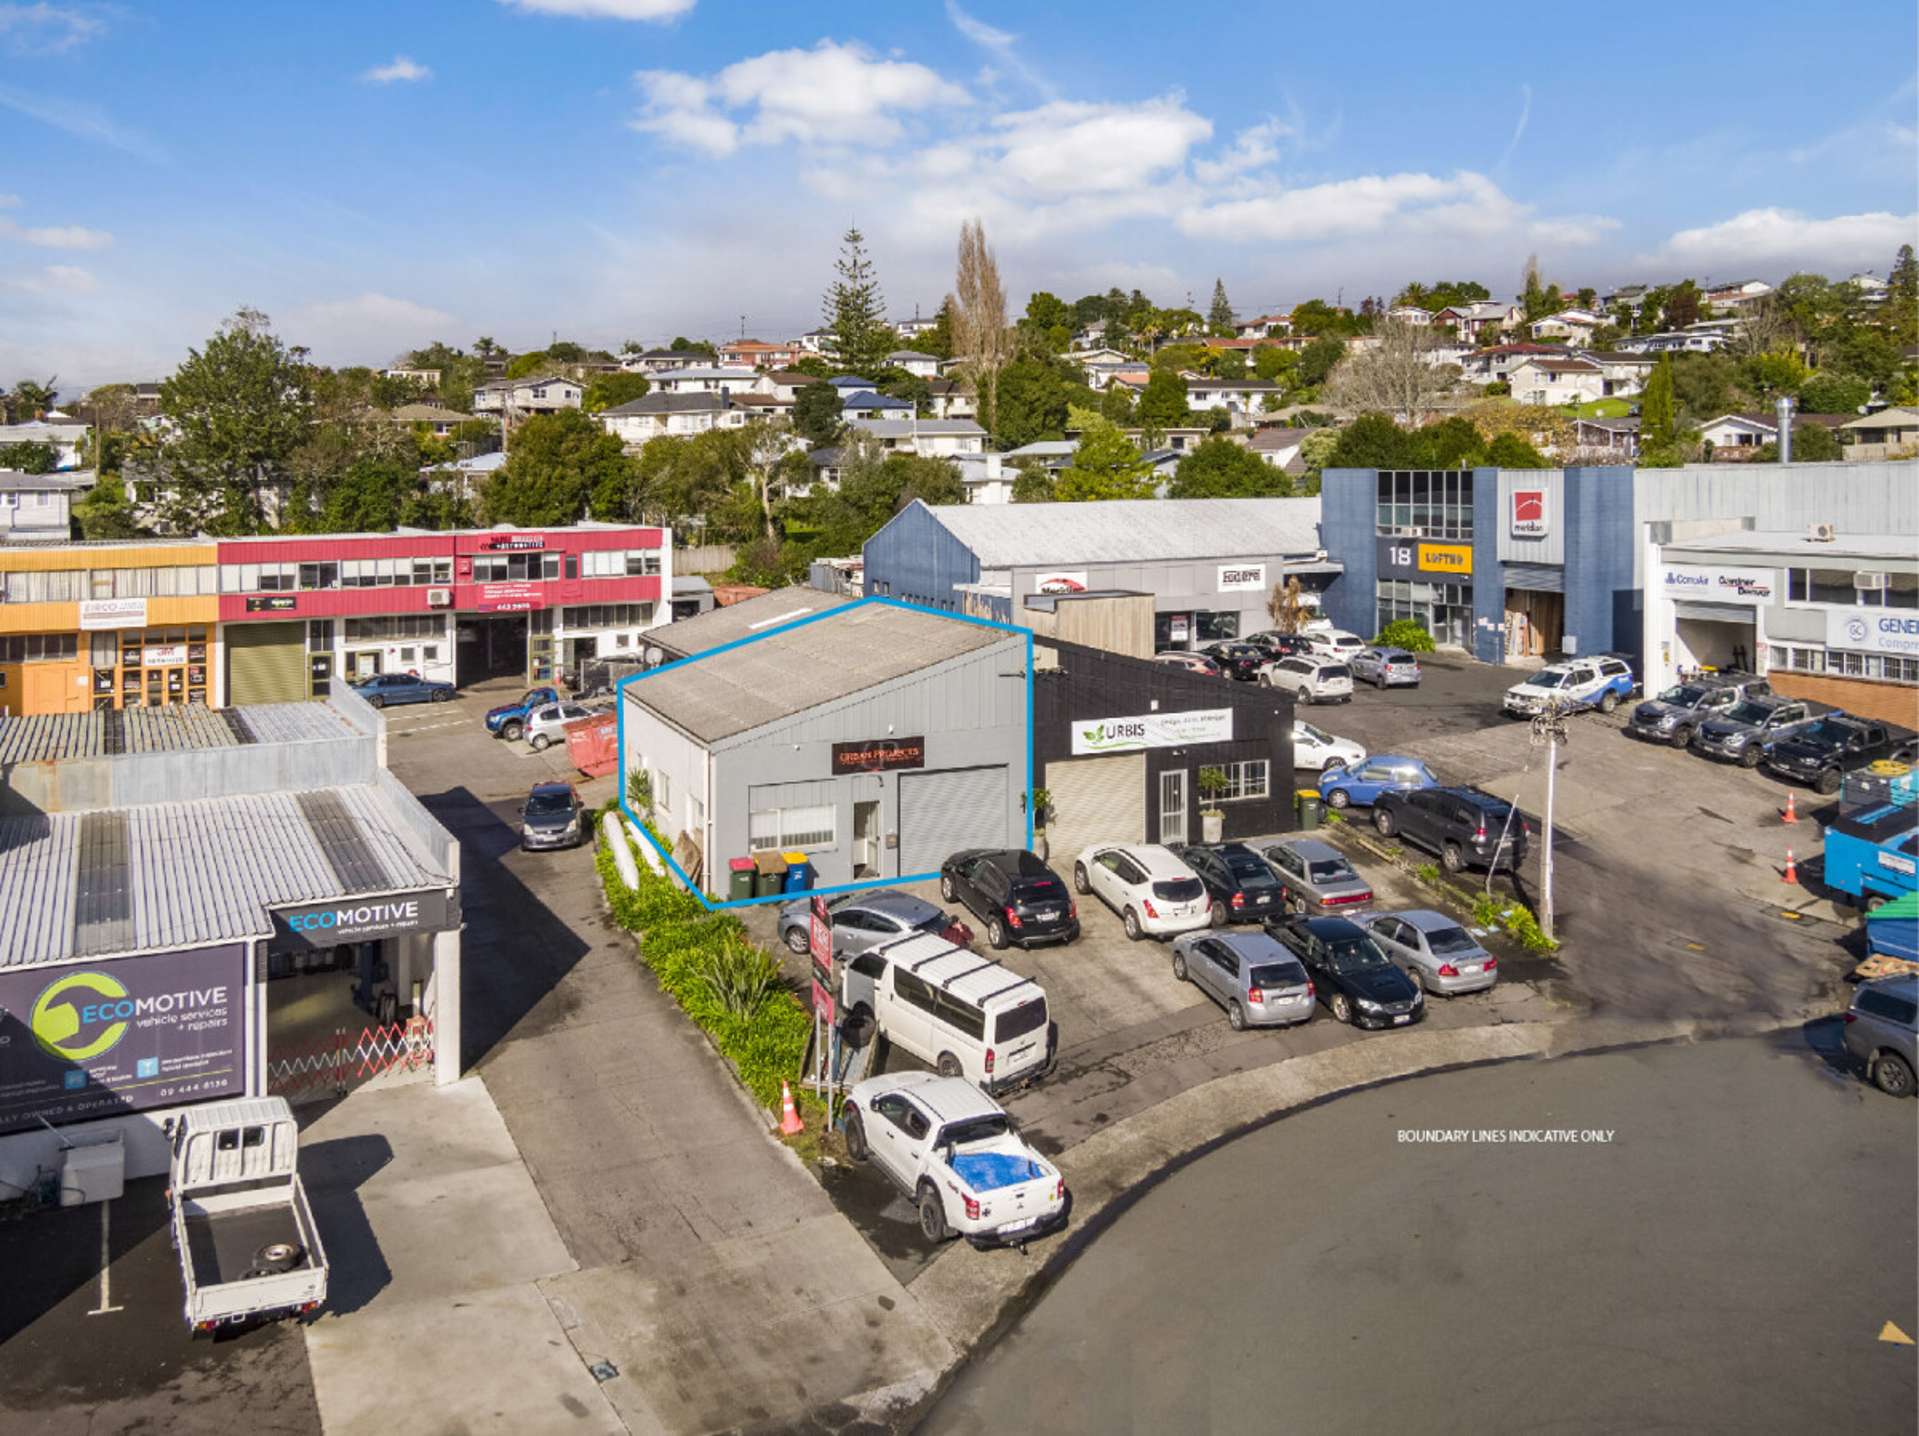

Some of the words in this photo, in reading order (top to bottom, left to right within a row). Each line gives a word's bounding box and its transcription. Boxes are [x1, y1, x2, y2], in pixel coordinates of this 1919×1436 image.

[1389, 546, 1411, 565] 18
[1879, 617, 1919, 634] GENE
[1106, 724, 1145, 739] URBIS
[289, 901, 418, 932] ECOMOTIVE
[82, 986, 227, 1024] ECOMOTIVE
[136, 1013, 178, 1029] vehicle
[180, 1007, 228, 1021] services
[188, 1018, 228, 1031] repairs
